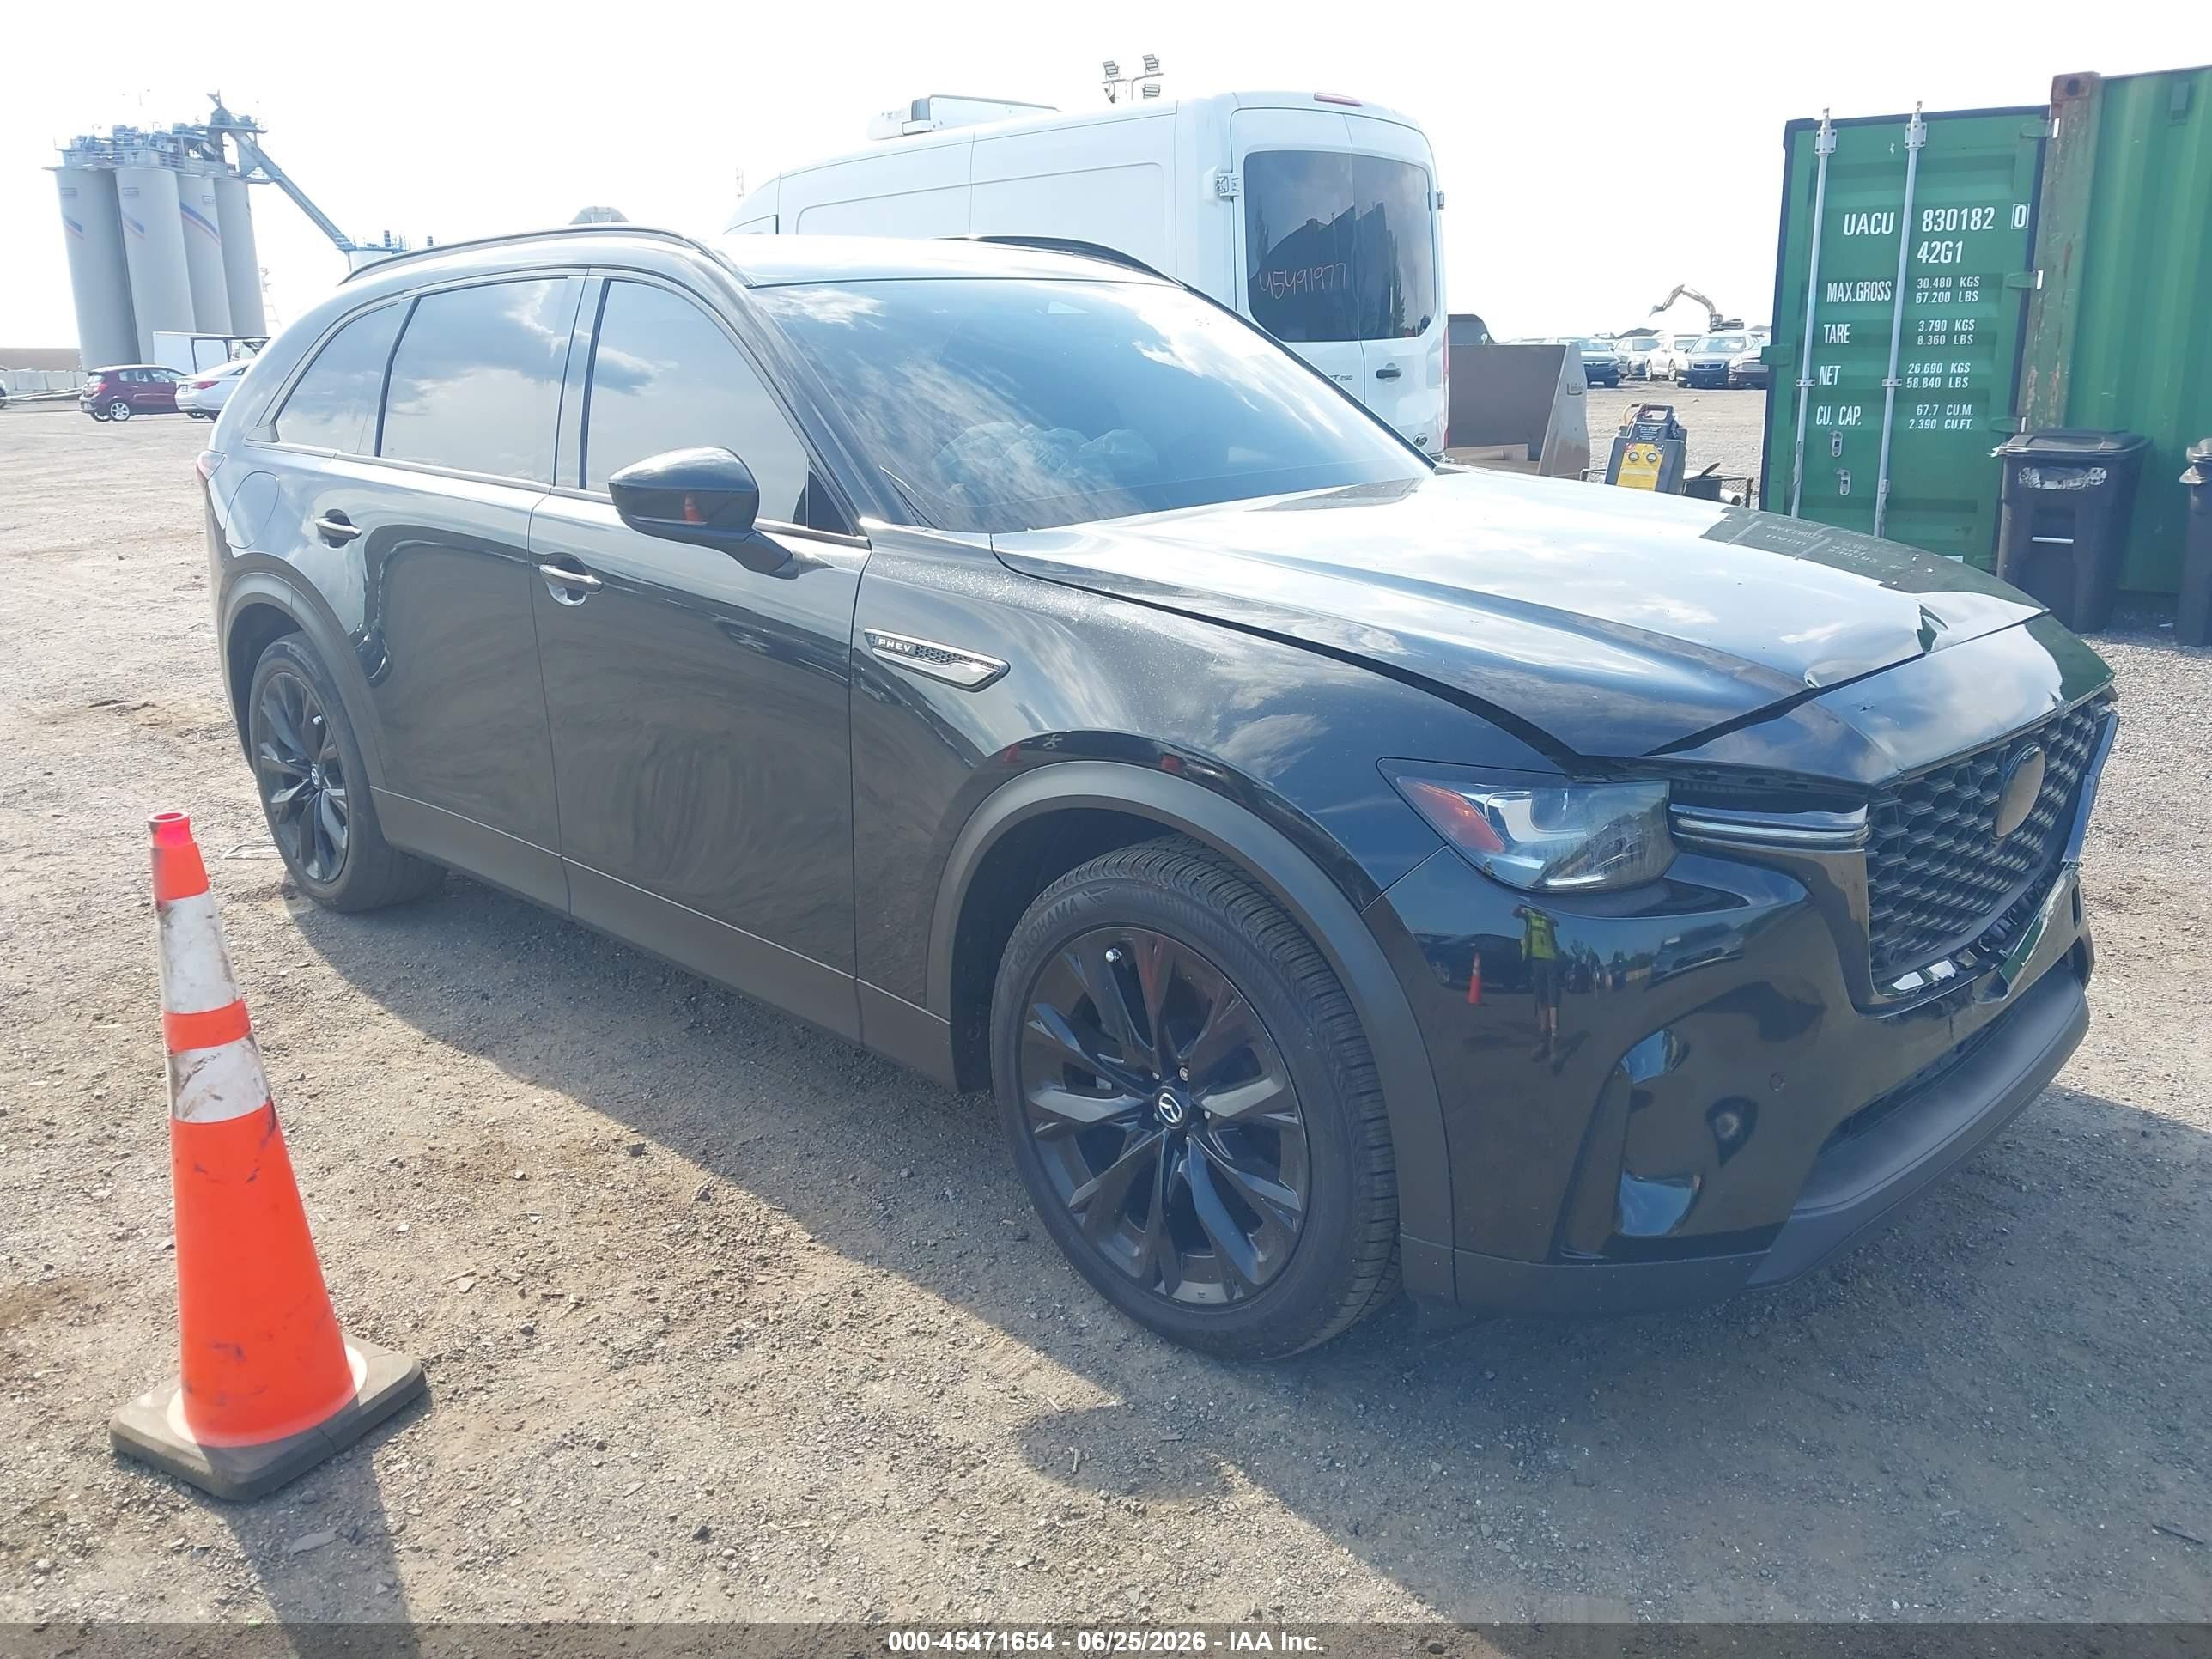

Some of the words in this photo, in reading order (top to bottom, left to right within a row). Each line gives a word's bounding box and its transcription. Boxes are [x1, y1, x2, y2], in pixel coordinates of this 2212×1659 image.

[1844, 212, 1894, 235] UACU
[1922, 207, 1995, 232] 830182
[1917, 240, 1964, 264] 42G1
[1259, 263, 1346, 299] 45491977
[1917, 277, 1952, 289] 30.480
[1960, 276, 1980, 288] KGS
[1826, 281, 1892, 302] MAX.GROSS
[1916, 291, 1951, 303] 67.200
[1958, 291, 1978, 302] LBS
[1918, 320, 1947, 331] 3.790
[1954, 319, 1975, 331] KGS
[1824, 323, 1850, 343] TARE
[1917, 334, 1946, 345] 8.360
[1954, 334, 1973, 345] LBS
[1908, 362, 1942, 374] 26.690
[1950, 362, 1971, 374] KGS
[1819, 365, 1841, 386] NET
[1906, 377, 1942, 388] 58.840
[1948, 377, 1968, 388] LBS
[1816, 406, 1832, 425] CU.
[1838, 406, 1862, 426] CAP.
[1917, 404, 1939, 416] 67.7
[1946, 404, 1974, 416] CU.M.
[1909, 419, 1937, 429] 2.390
[878, 638, 911, 653] PHEV
